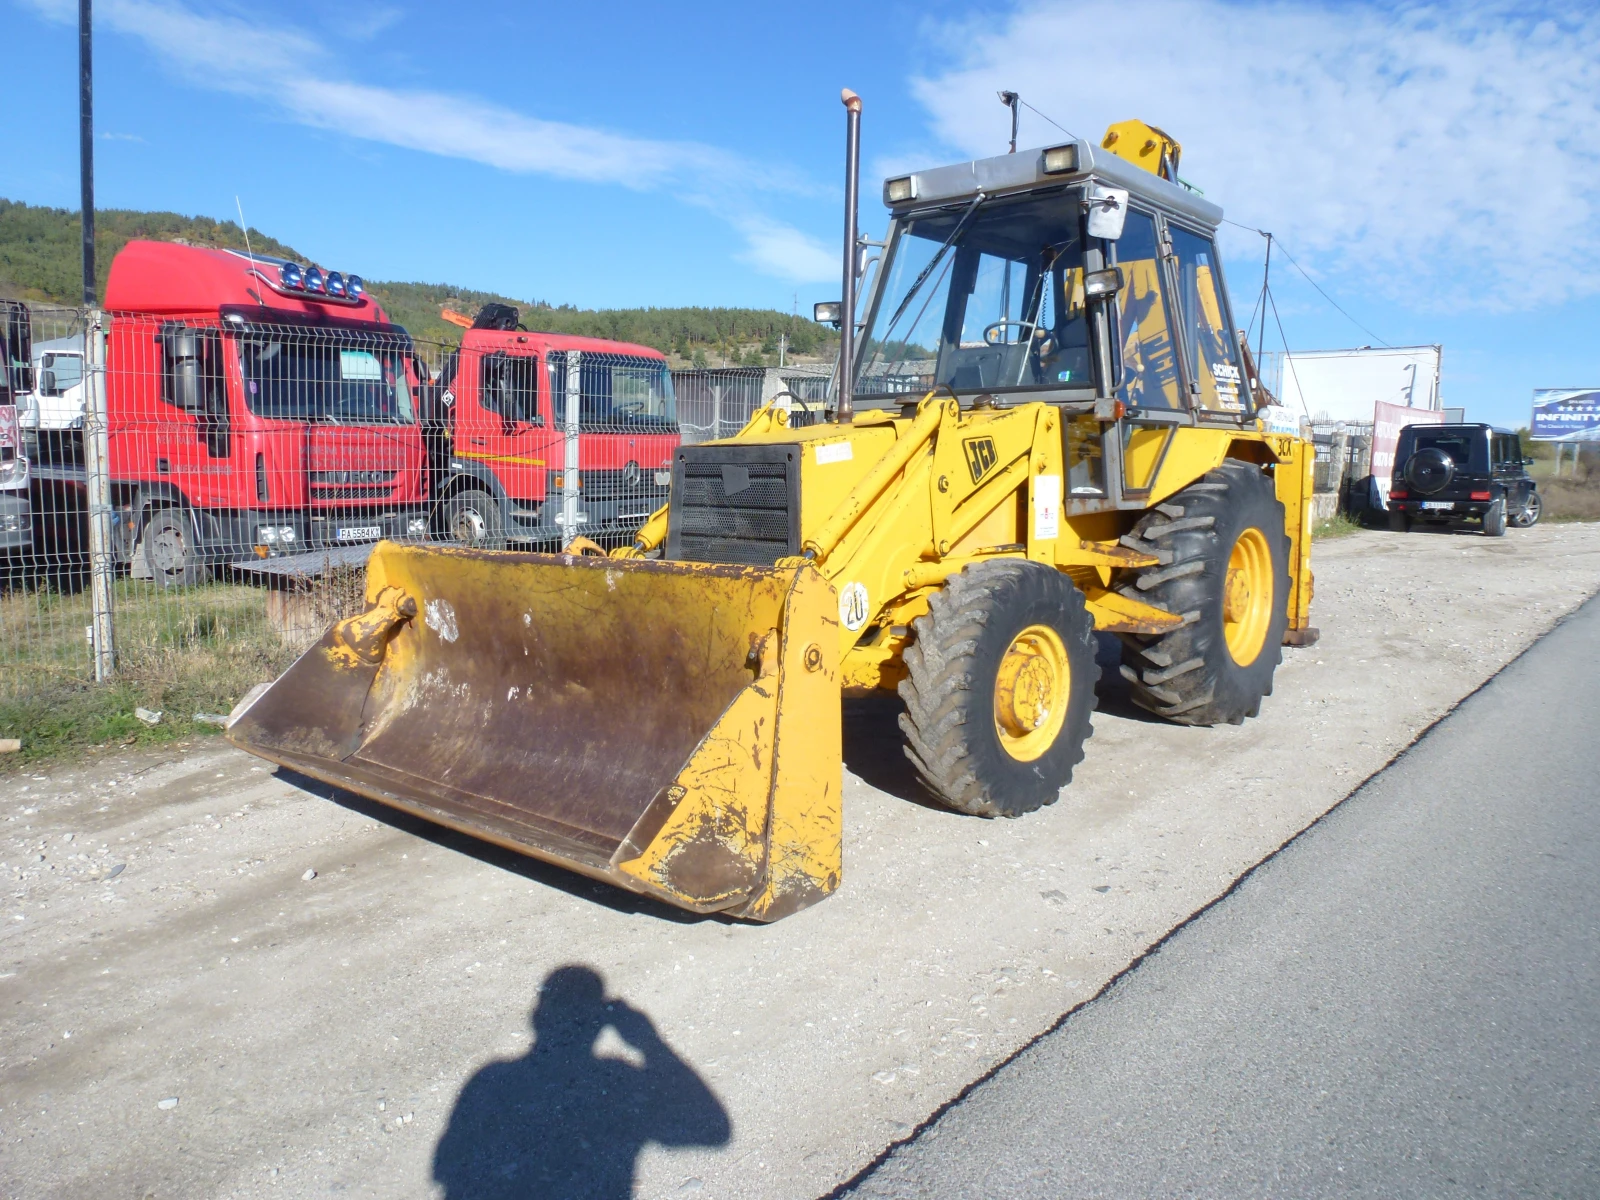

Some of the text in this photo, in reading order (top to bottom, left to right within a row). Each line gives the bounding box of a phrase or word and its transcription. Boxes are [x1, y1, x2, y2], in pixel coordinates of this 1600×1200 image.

[1536, 413, 1600, 421] INFINITY
[1278, 438, 1292, 457] 3CX
[968, 439, 997, 481] JCB
[328, 471, 383, 484] IVECO
[845, 591, 864, 625] 20
